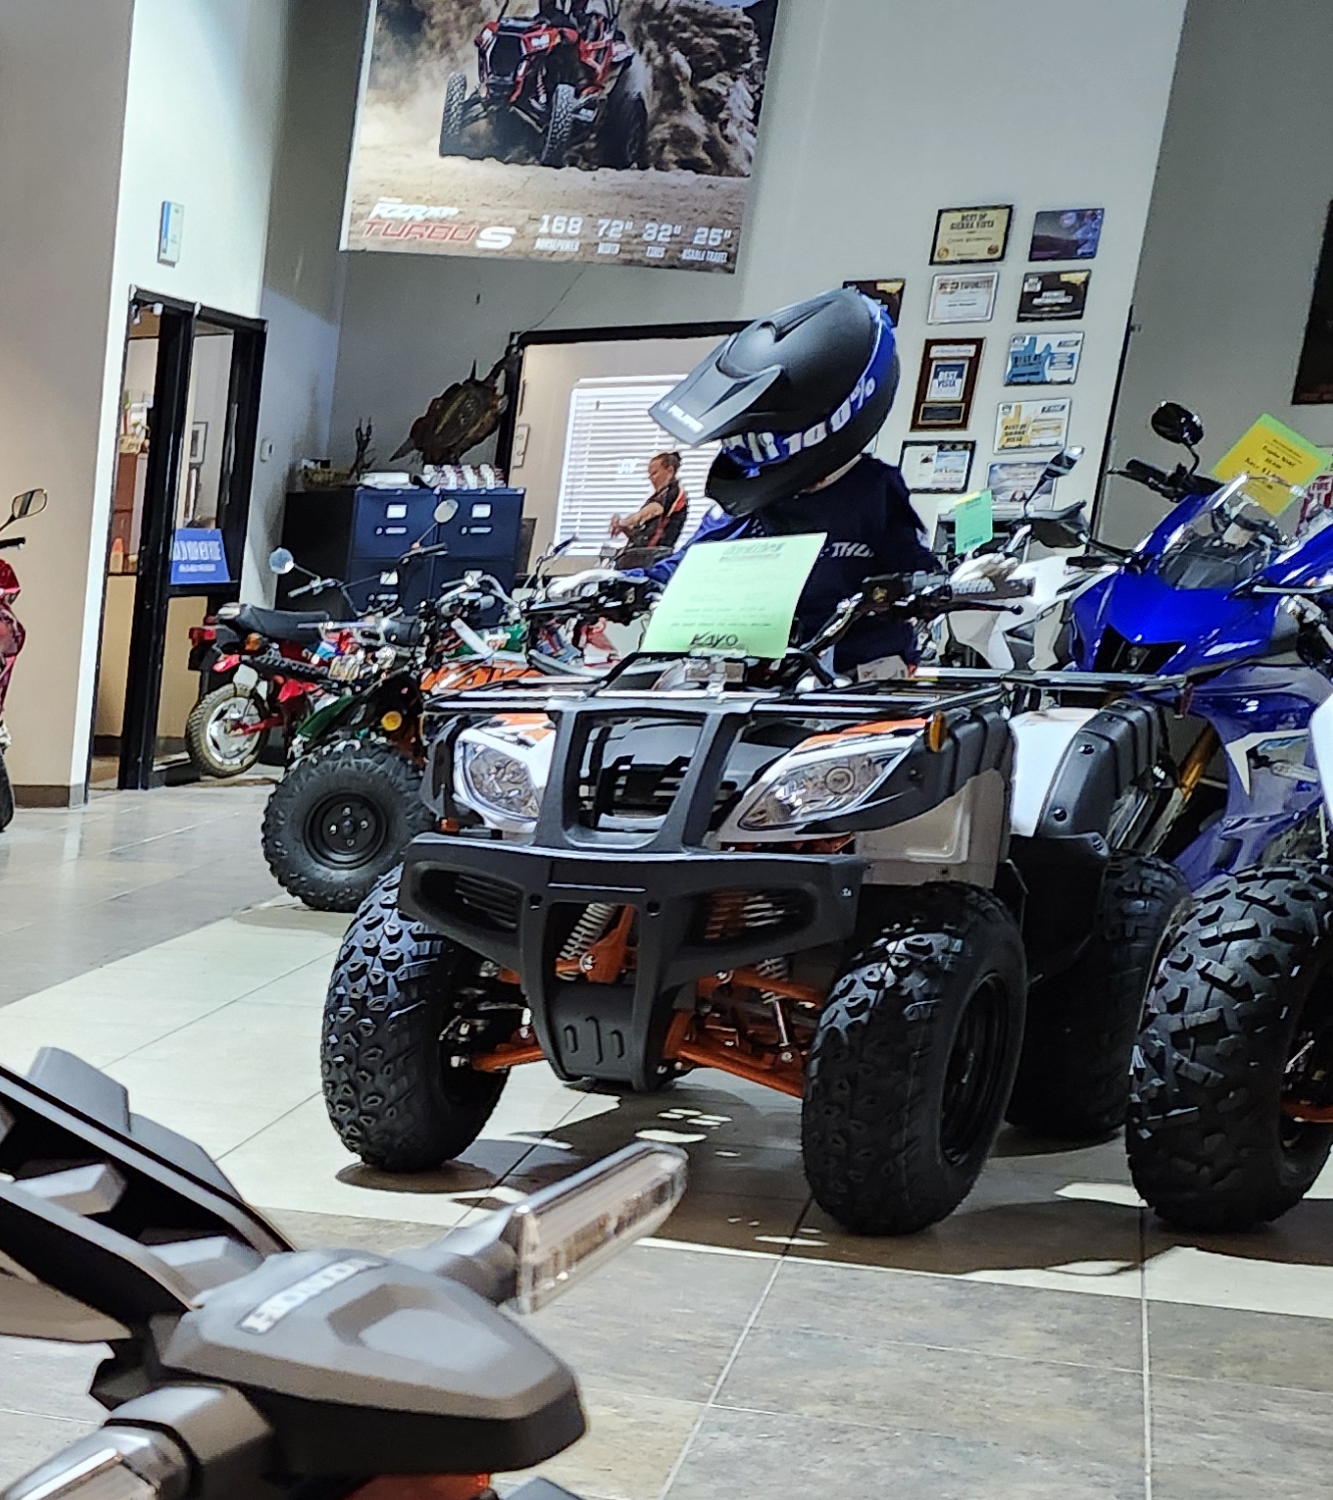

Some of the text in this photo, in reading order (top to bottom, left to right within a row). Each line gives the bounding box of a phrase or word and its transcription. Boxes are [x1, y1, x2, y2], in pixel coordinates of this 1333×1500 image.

[362, 219, 518, 250] TURBO S
[538, 213, 584, 236] 168
[782, 376, 877, 456] 100%
[690, 630, 739, 648] KAYO
[240, 1257, 382, 1334] HONDA
